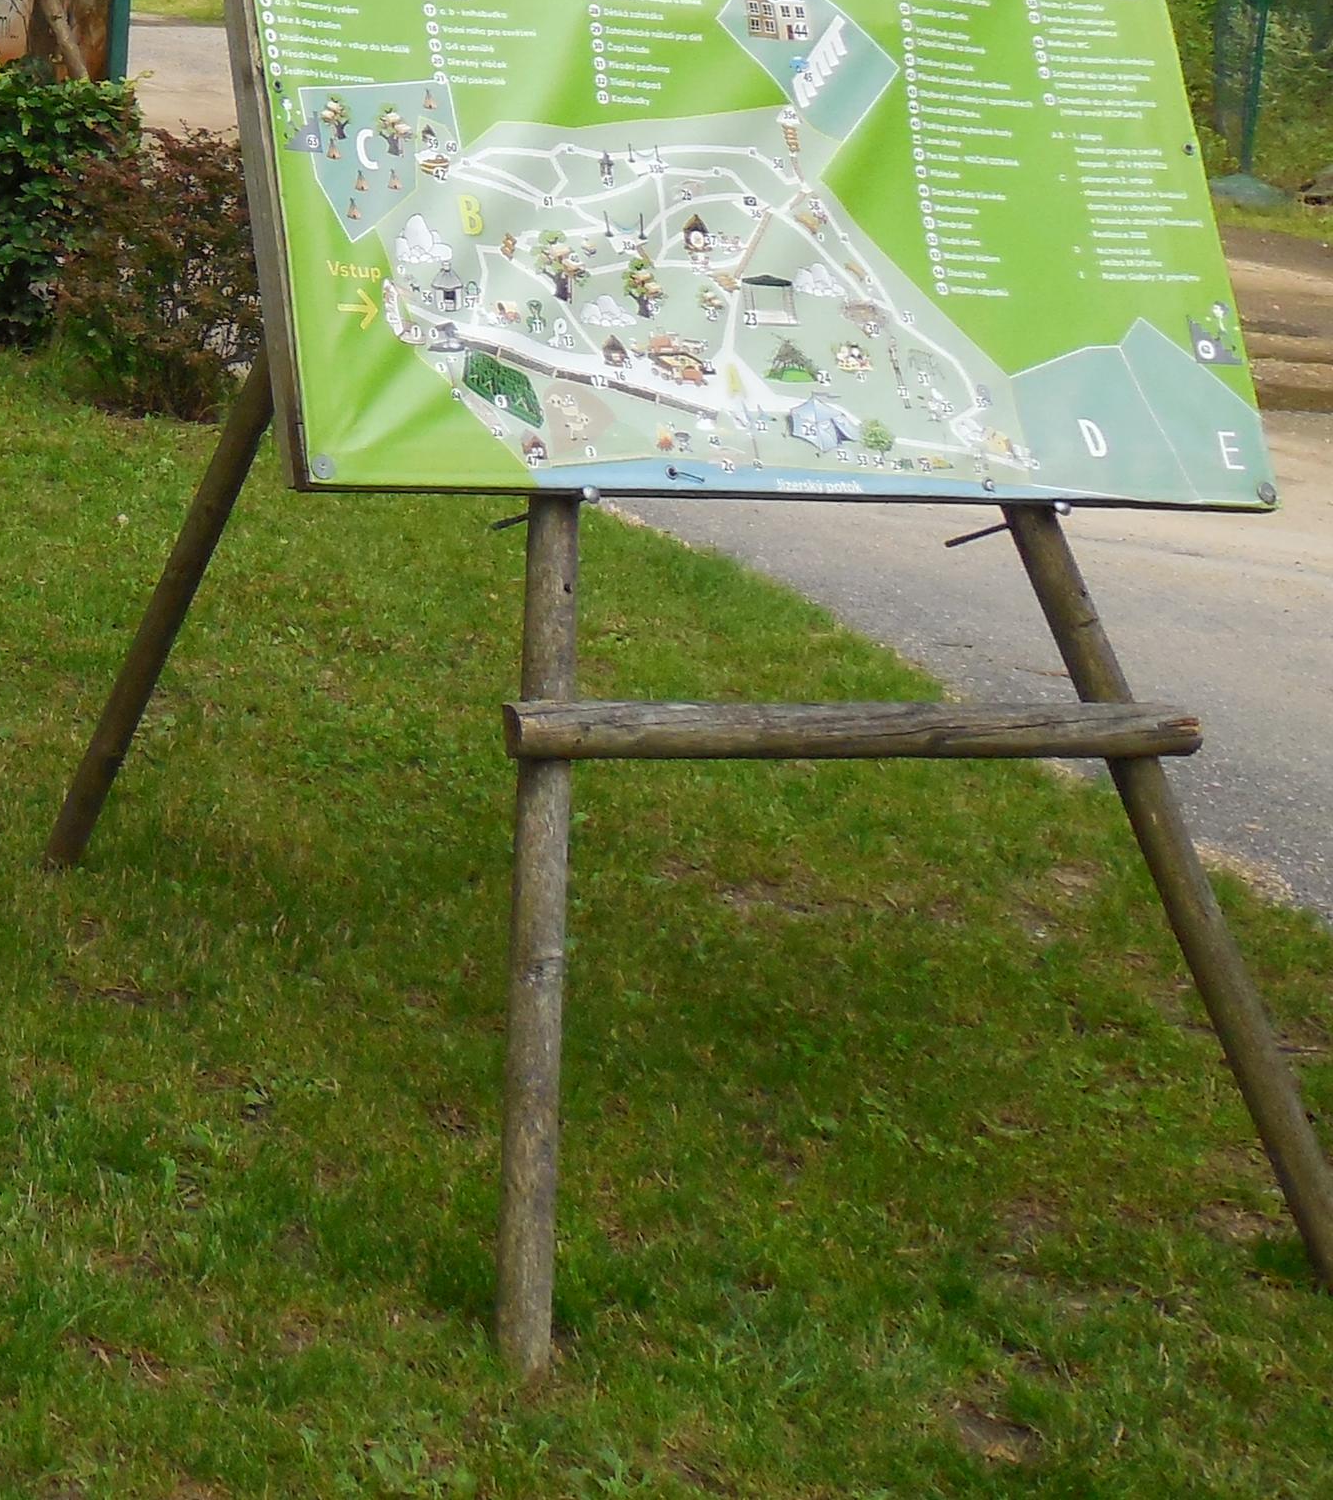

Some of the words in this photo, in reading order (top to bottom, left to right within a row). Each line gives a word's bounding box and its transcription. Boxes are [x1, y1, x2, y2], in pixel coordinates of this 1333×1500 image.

[356, 128, 379, 170] C
[446, 143, 457, 153] 60
[434, 168, 446, 181] 42
[544, 196, 553, 206] 61
[459, 195, 484, 235] B
[327, 260, 381, 282] Vstup
[422, 292, 432, 303] 56
[744, 312, 757, 325] 23
[533, 322, 542, 331] 11
[591, 375, 606, 386] 12
[615, 371, 625, 381] 16
[818, 371, 831, 383] 24
[497, 396, 504, 407] 9
[802, 425, 816, 436] 26
[1077, 418, 1107, 458] D
[1218, 431, 1246, 470] E
[826, 480, 863, 493] potok
